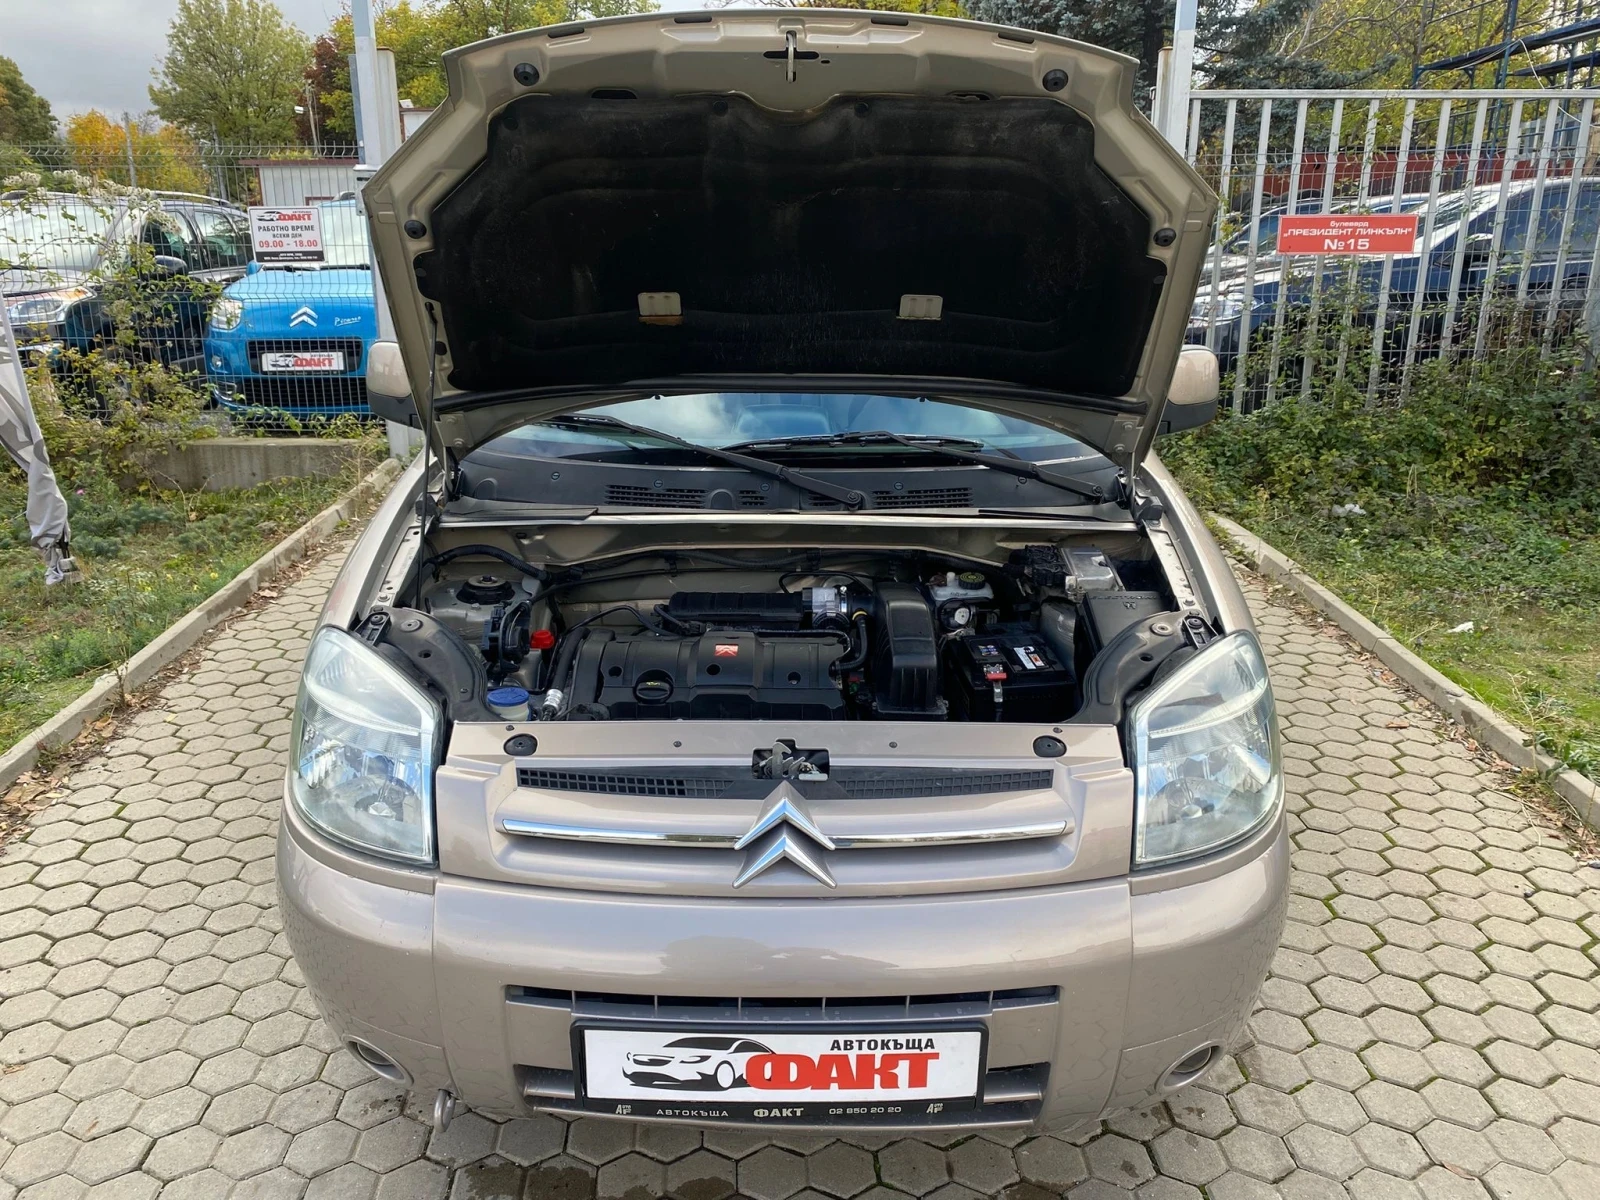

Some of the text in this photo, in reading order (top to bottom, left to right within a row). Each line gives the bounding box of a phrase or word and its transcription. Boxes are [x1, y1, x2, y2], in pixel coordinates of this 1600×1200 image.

[278, 213, 312, 221] ФАКТ
[259, 240, 284, 248] 09.00
[294, 239, 318, 248] 18.00
[294, 357, 334, 367] ФАКТ
[830, 1038, 935, 1052] АВТОКЪЩА
[745, 1052, 940, 1090] ФАКТ
[753, 1107, 804, 1118] ФАКТ
